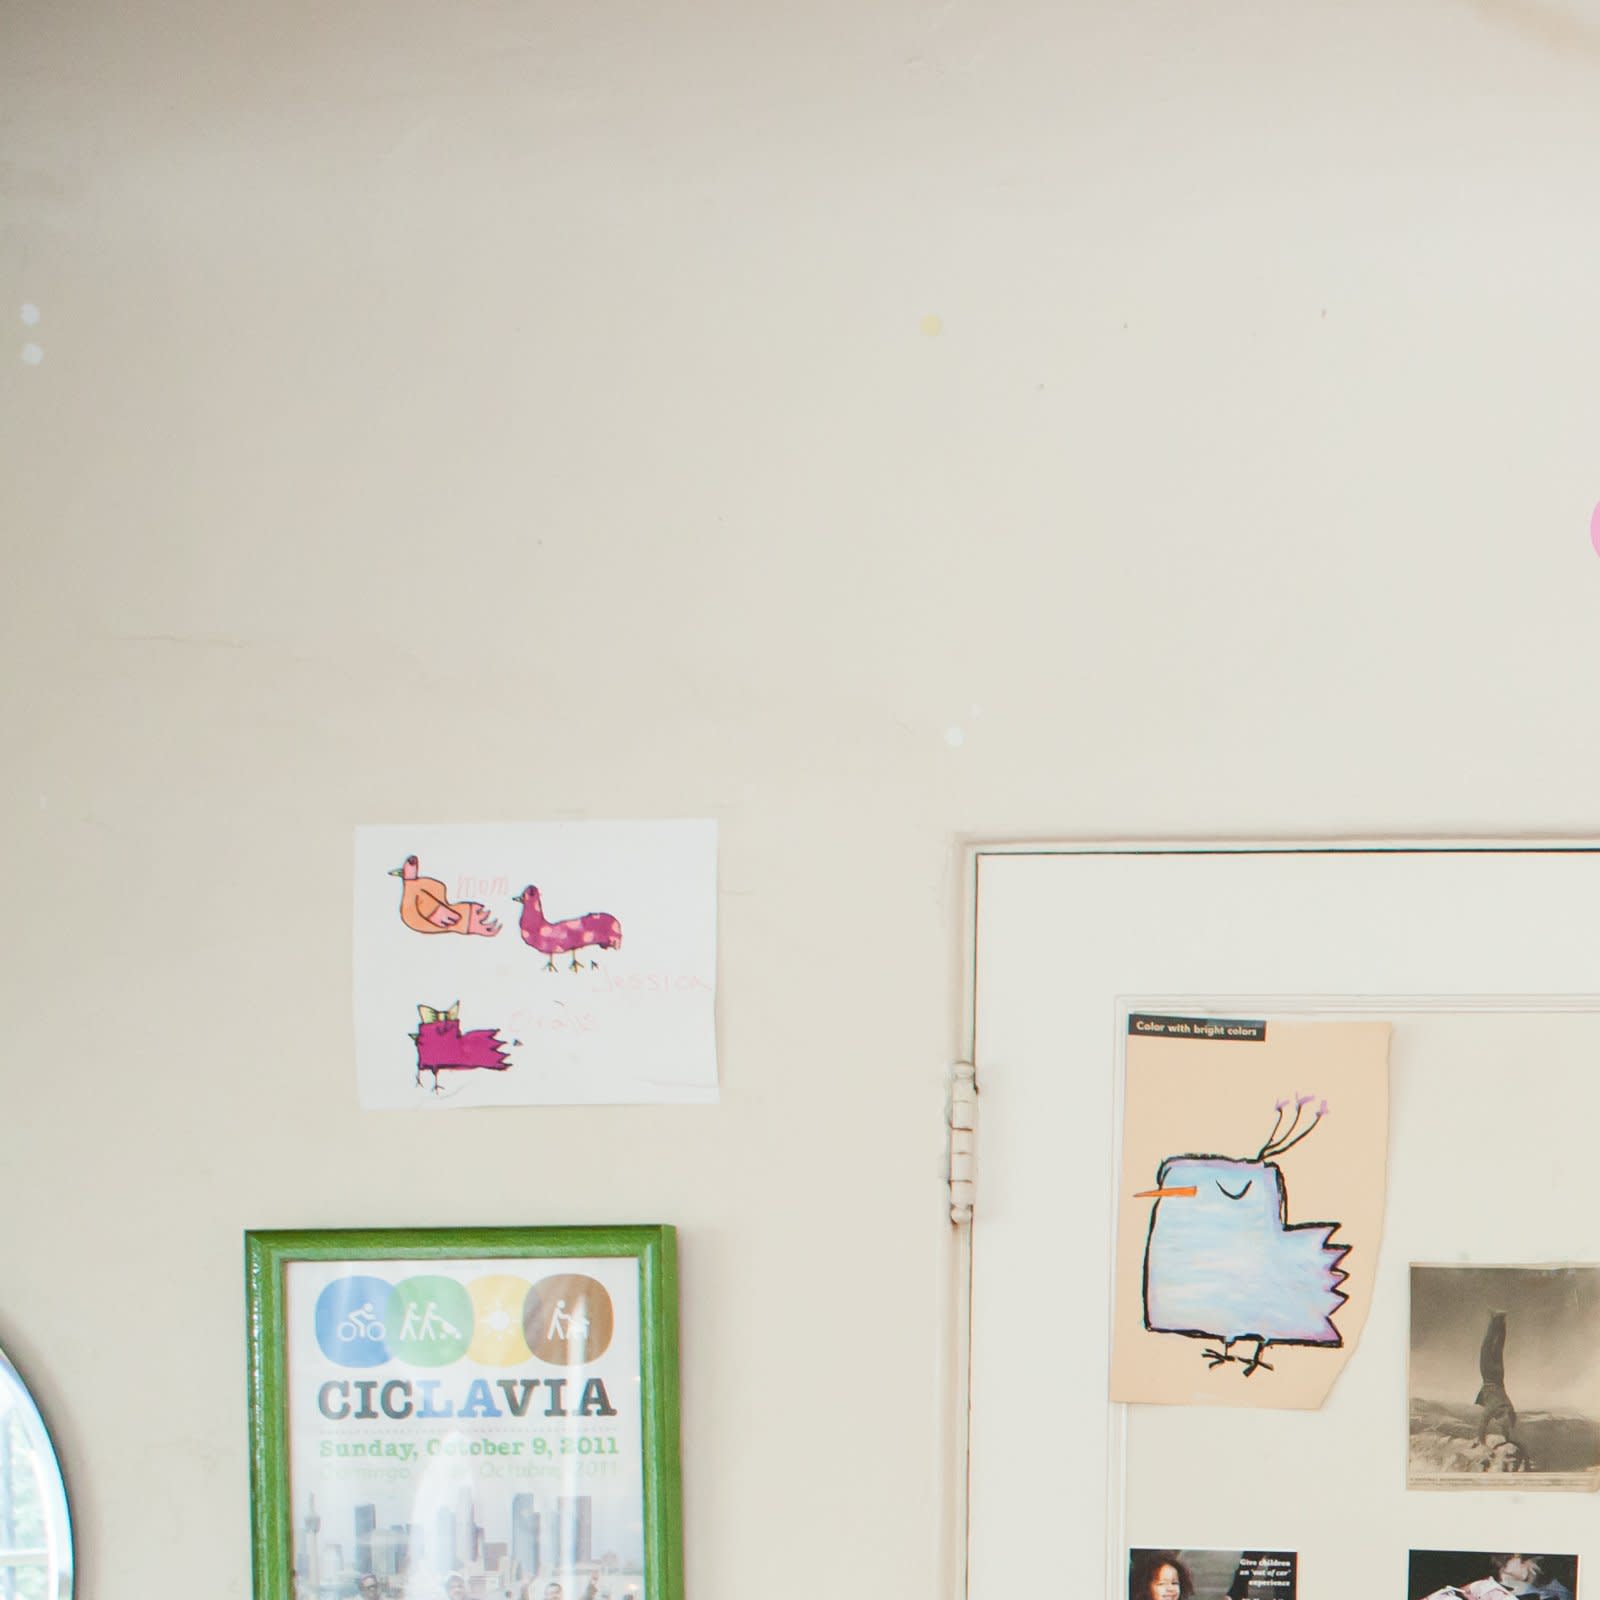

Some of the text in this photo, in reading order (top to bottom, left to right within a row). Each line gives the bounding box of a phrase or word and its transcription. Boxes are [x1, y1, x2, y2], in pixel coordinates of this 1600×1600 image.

[1136, 1021, 1257, 1037] Color with bright colors
[318, 1377, 617, 1420] CICLAVIA
[320, 1439, 419, 1461] Sunday,
[532, 1437, 552, 1460] 9,
[560, 1436, 620, 1456] 2011
